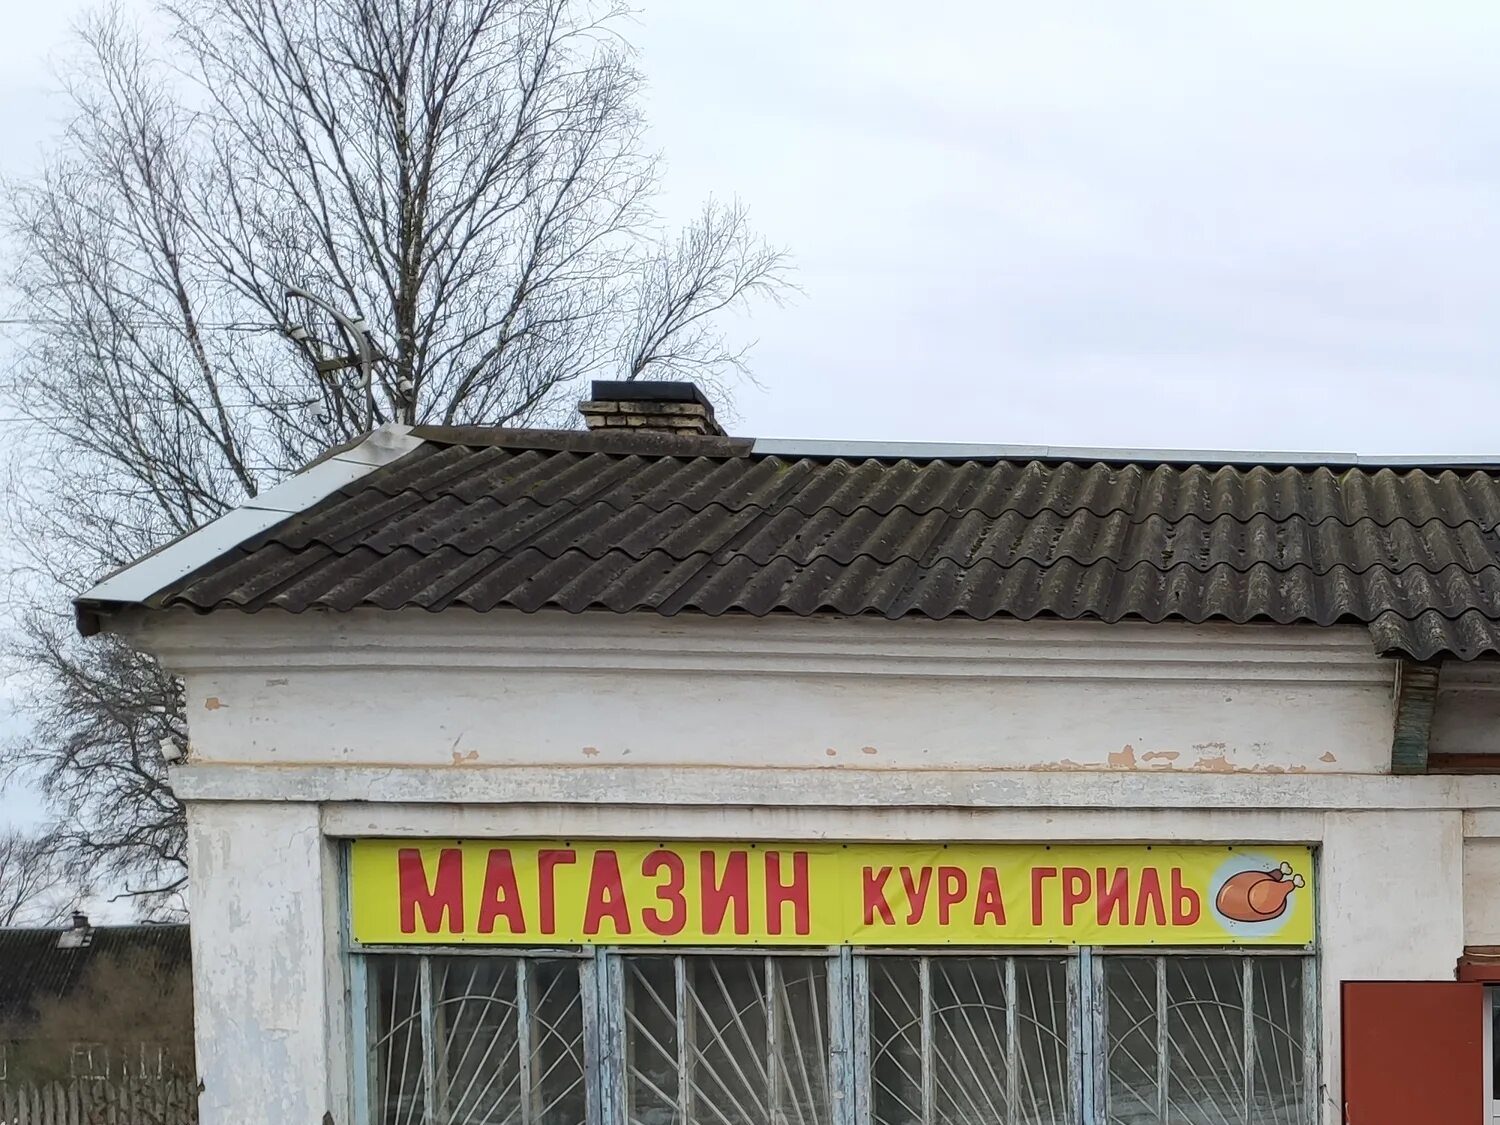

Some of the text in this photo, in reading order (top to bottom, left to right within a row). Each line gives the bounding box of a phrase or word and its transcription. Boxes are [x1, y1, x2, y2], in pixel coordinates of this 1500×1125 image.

[397, 848, 1202, 936] МАГАЗИН КУРА ГРИЛЬ
